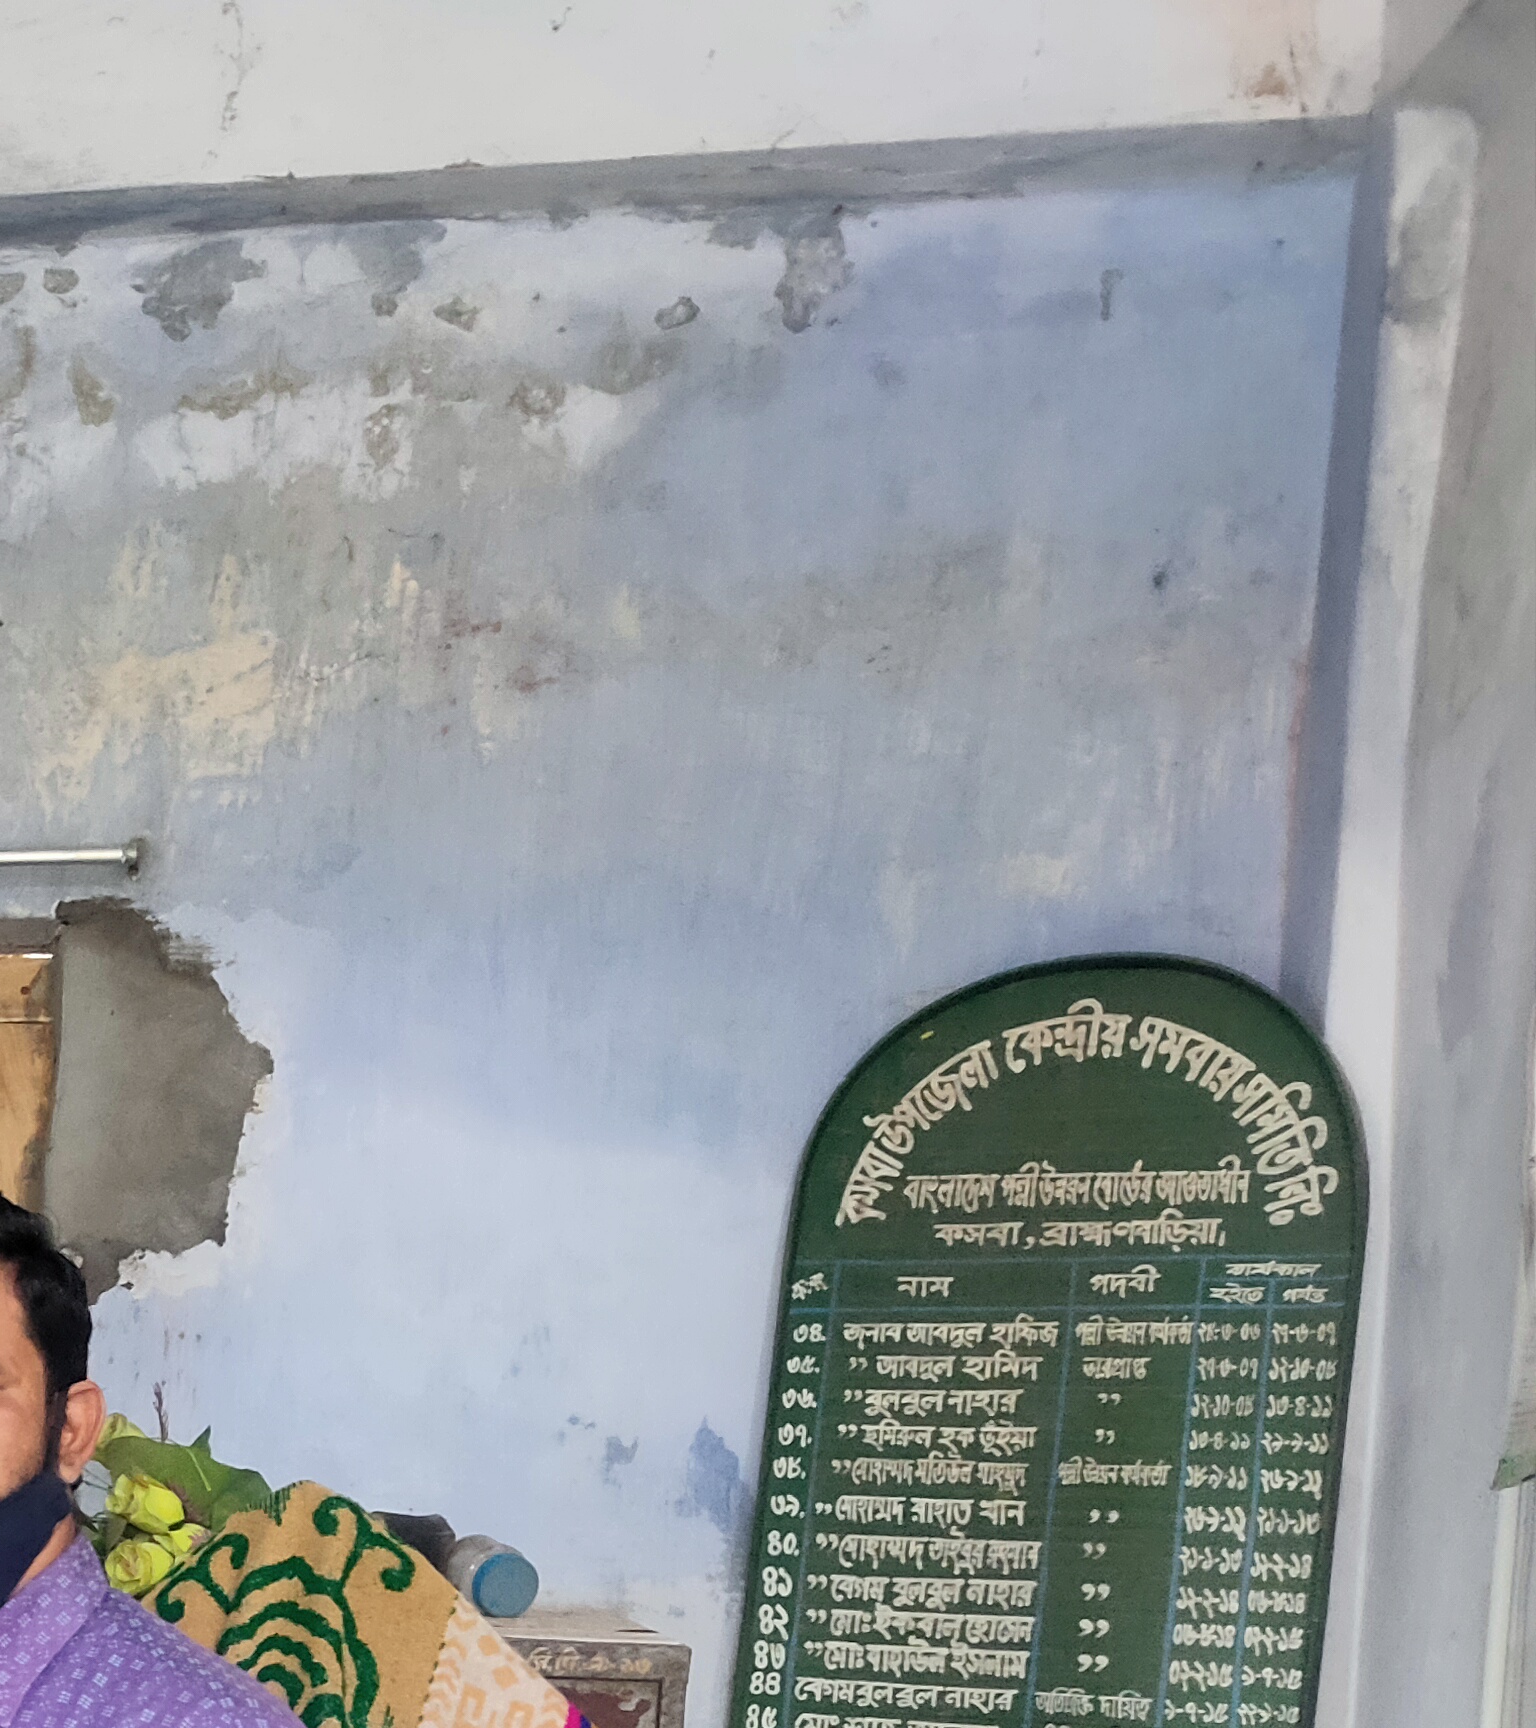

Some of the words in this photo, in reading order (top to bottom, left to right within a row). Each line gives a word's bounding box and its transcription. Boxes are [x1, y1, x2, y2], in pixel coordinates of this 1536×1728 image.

[1002, 998, 1132, 1073] কেন্দ্রীয়
[1129, 1016, 1256, 1102] সমবায়
[862, 1040, 999, 1154] উপজেলা
[1232, 1073, 1327, 1175] সমিতি
[835, 1142, 903, 1226] কসবা
[903, 1174, 1001, 1214] বাংলাদেশ
[1093, 1160, 1156, 1210] বোর্ডের
[1264, 1165, 1339, 1226] লিঃ
[897, 1276, 954, 1298] নাম
[1090, 1264, 1161, 1299] পদবী
[843, 1323, 904, 1350] জনাব
[906, 1323, 987, 1348] আবদুল
[990, 1313, 1060, 1348] হাফিজ
[877, 1355, 956, 1382] আবদুল
[963, 1350, 1043, 1381] হামিদ
[865, 1389, 946, 1417] বুলবুল
[947, 1389, 1024, 1417] নাহার
[778, 1423, 812, 1447] ৩৭.
[938, 1427, 975, 1454] হক
[773, 1457, 806, 1479] ৩৮.
[770, 1495, 805, 1518] ৩৯.
[910, 1497, 975, 1528] রাহাত
[979, 1500, 1026, 1526] খান
[767, 1530, 800, 1557] ৪০.
[839, 1534, 929, 1570] মোহাম্মদ
[762, 1566, 793, 1598] ৪১
[830, 1574, 890, 1602] বেগম
[892, 1578, 965, 1610] বুলবুল
[966, 1580, 1038, 1610] নাহার
[758, 1603, 789, 1641] ৪২
[830, 1609, 872, 1636] মোঃ
[873, 1603, 964, 1642] ইকবাল
[965, 1615, 1035, 1643] হোসেন
[754, 1640, 786, 1670] ৪৩
[823, 1641, 865, 1671] মোঃ
[951, 1641, 1030, 1679] ইসলাম
[749, 1671, 781, 1695] ৪৪
[794, 1677, 856, 1703] বেগম
[856, 1680, 943, 1710] বুলবুল
[945, 1686, 1019, 1714] নাহার
